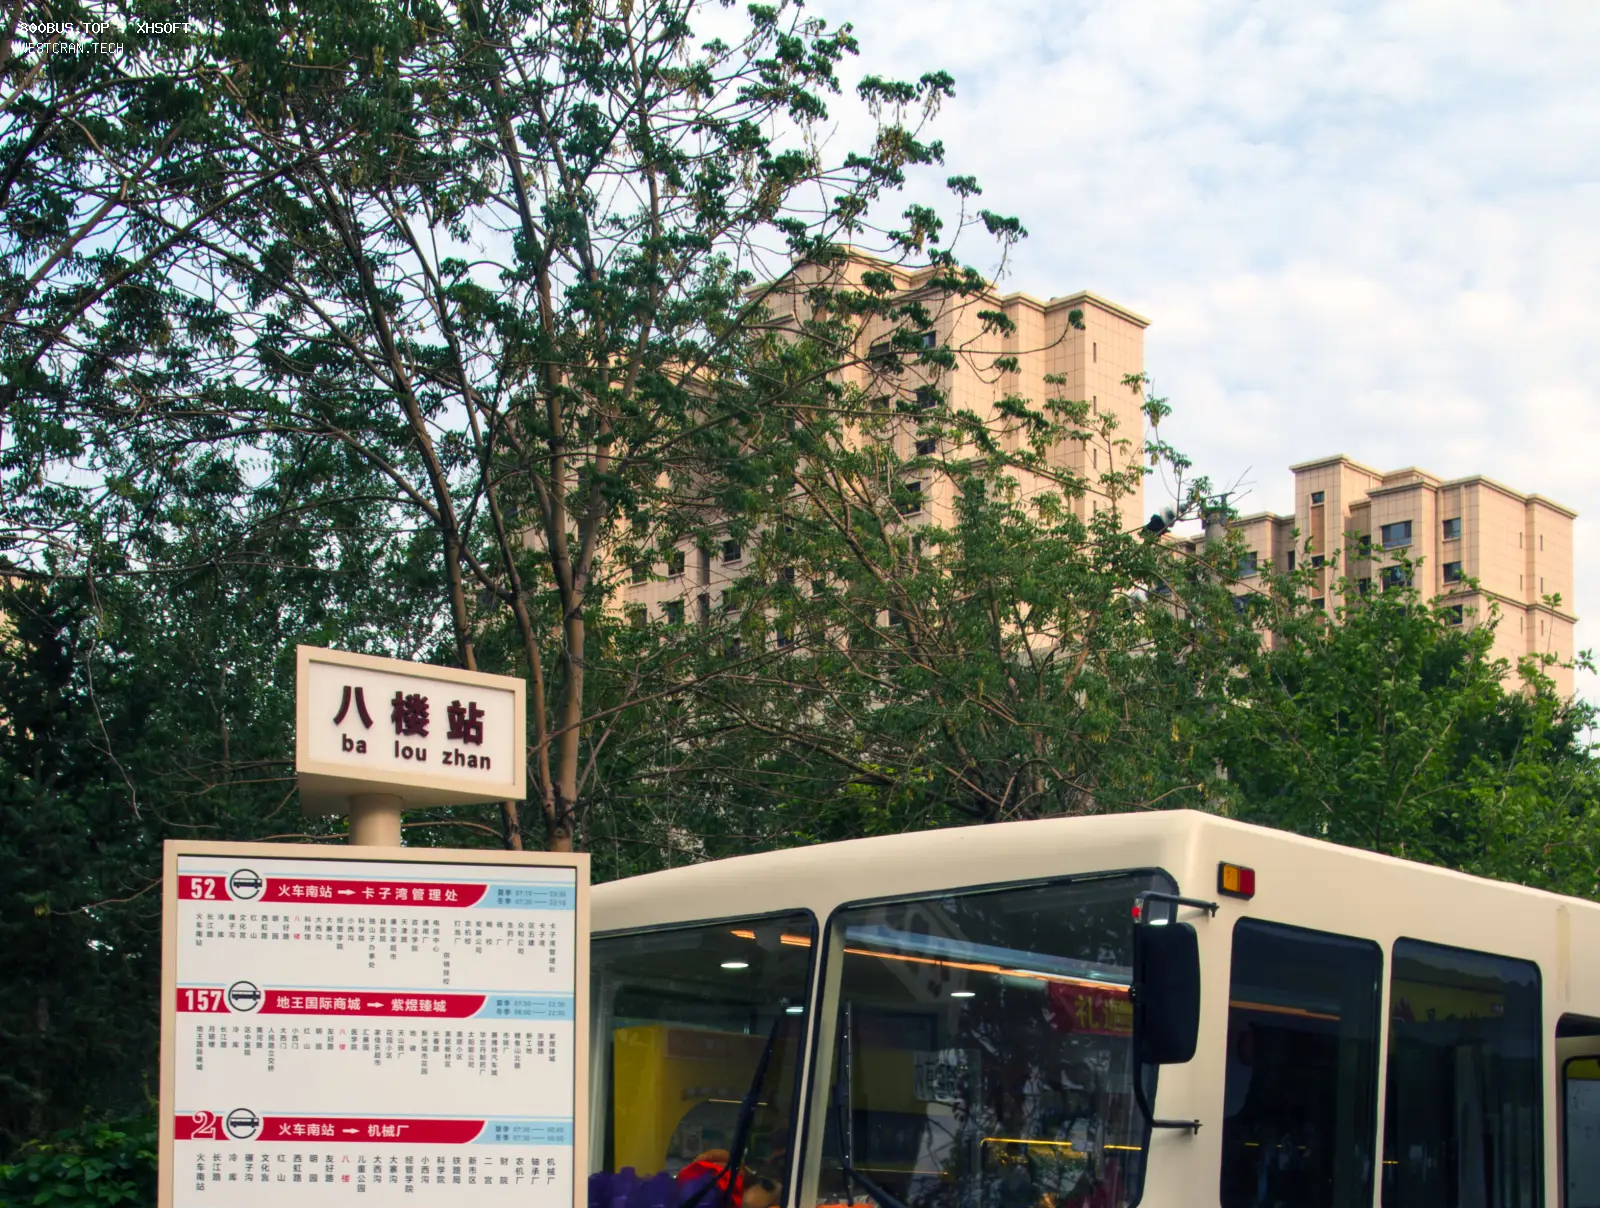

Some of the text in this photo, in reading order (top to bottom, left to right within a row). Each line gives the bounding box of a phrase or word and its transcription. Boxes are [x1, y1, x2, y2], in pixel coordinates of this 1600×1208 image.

[333, 685, 485, 745] 八楼站
[342, 733, 491, 770] ba lou zhan
[191, 878, 459, 902] 52 火车南站 卡子湾管理处
[195, 912, 203, 947] 火车南站
[206, 913, 214, 939] 长江路
[239, 914, 247, 939] 文化宫
[249, 914, 258, 940] 红山
[293, 916, 301, 940] 八楼
[538, 922, 546, 947] 卡子湾
[548, 922, 556, 973] 卡子湾管理处
[186, 990, 447, 1013] 157 地王国际商城 紫煜臻城
[303, 1027, 311, 1050] 红山
[338, 1029, 347, 1051] 八楼
[191, 1111, 410, 1140] 2 火车南站 机械厂
[195, 1153, 206, 1191] 火车南站
[211, 1152, 222, 1182] 长江路
[228, 1153, 238, 1182] 冷库
[260, 1153, 271, 1182] 文化宫
[276, 1153, 287, 1182] 红山
[292, 1153, 303, 1183] 西虹路
[308, 1154, 319, 1183] 明园
[324, 1154, 335, 1183] 友好路
[340, 1155, 351, 1183] 八楼
[356, 1155, 367, 1193] 儿童公园
[372, 1155, 383, 1184] 大西沟
[388, 1155, 399, 1184] 大寨沟
[404, 1155, 415, 1194] 经管学院
[420, 1155, 430, 1184] 小西沟
[436, 1155, 446, 1184] 科学院
[452, 1156, 462, 1185] 铁路局
[468, 1156, 477, 1185] 新市区
[483, 1157, 493, 1185] 二宫
[499, 1156, 509, 1185] 财院
[515, 1157, 525, 1185] 农机厂
[530, 1157, 541, 1185] 轴承厂
[546, 1157, 556, 1186] 机械厂
